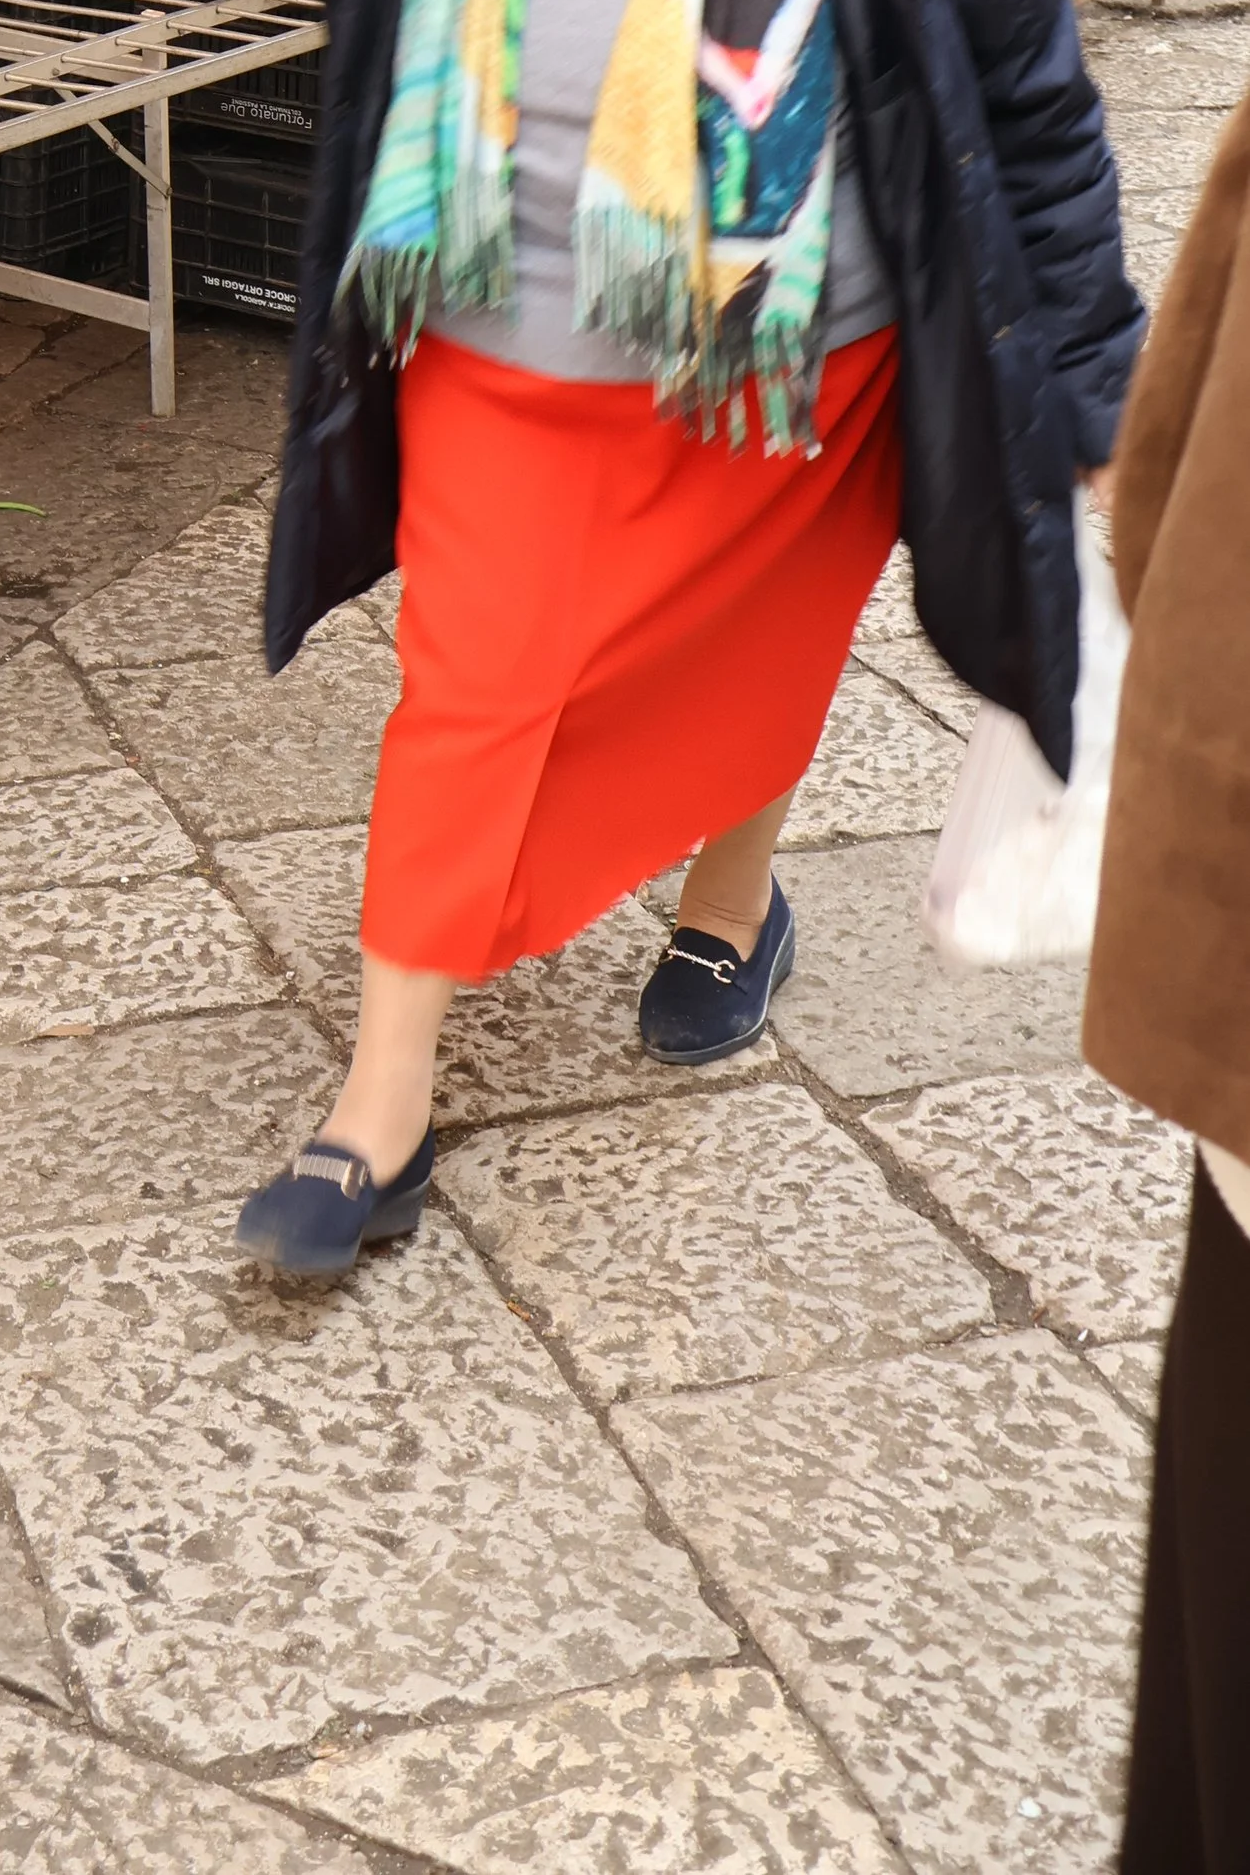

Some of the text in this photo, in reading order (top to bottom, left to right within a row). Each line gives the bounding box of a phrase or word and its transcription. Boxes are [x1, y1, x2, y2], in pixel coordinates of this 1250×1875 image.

[220, 102, 312, 129] Fortunato Due
[202, 275, 220, 286] SRL
[221, 280, 263, 296] ORTAGGI
[264, 288, 296, 304] CROCE
